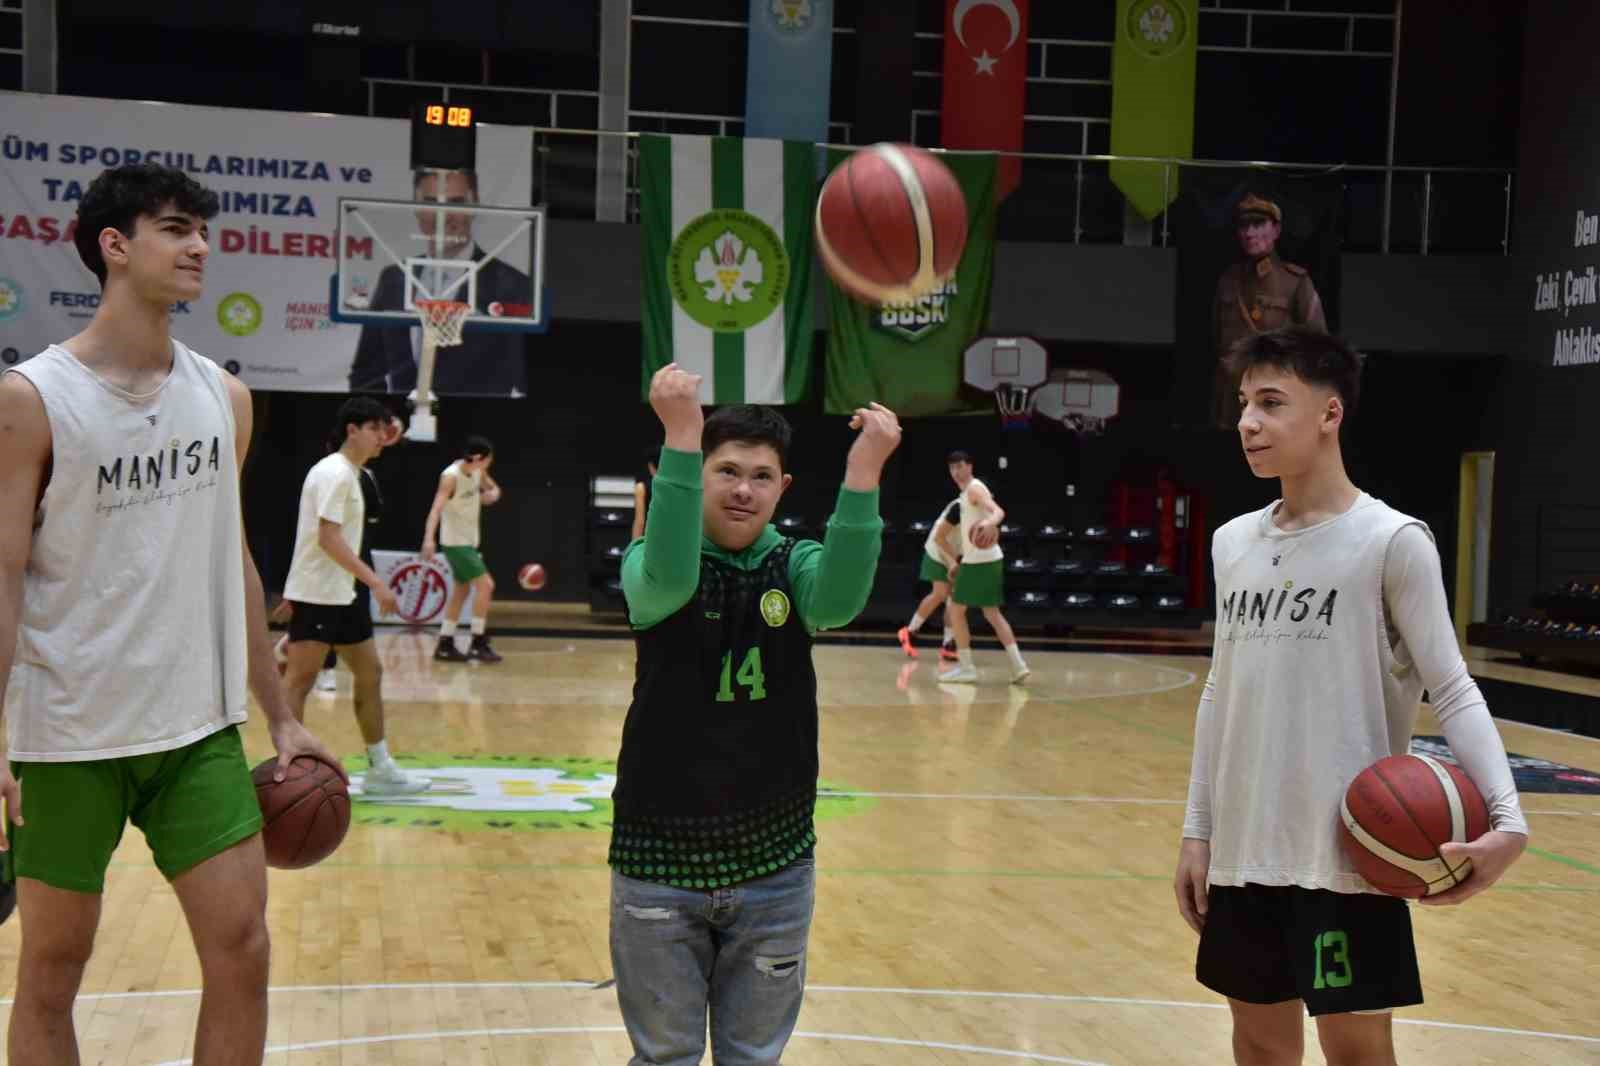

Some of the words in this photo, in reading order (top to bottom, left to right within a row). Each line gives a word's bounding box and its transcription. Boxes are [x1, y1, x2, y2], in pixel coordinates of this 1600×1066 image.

[426, 105, 444, 125] 19
[447, 107, 472, 127] 08
[58, 143, 331, 182] SPORCULARIMIZA
[340, 166, 373, 183] ve
[1574, 209, 1599, 248] Ben
[1535, 272, 1560, 310] Zeki
[1564, 265, 1597, 317] Çevik
[715, 646, 767, 702] 14
[1312, 930, 1353, 990] 13
